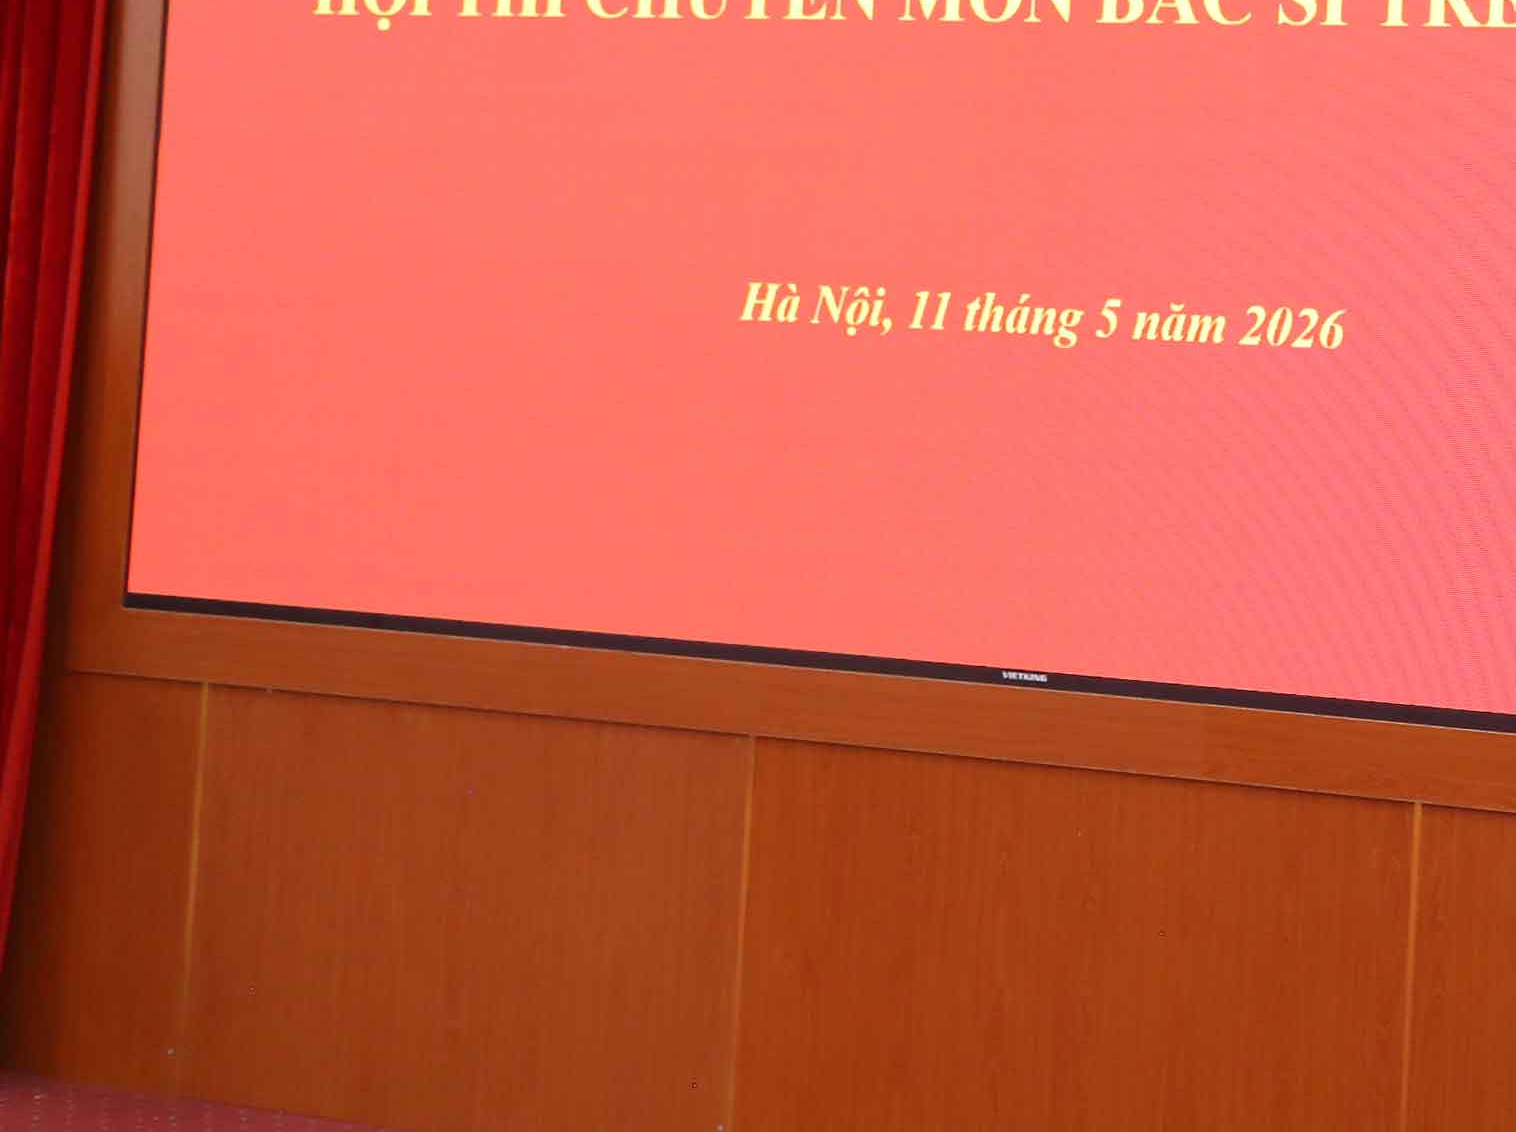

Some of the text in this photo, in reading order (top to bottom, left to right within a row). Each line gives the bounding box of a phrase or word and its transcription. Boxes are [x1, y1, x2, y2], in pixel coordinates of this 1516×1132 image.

[739, 281, 1347, 350] Hà Nội, 11 tháng 5 năm 2026
